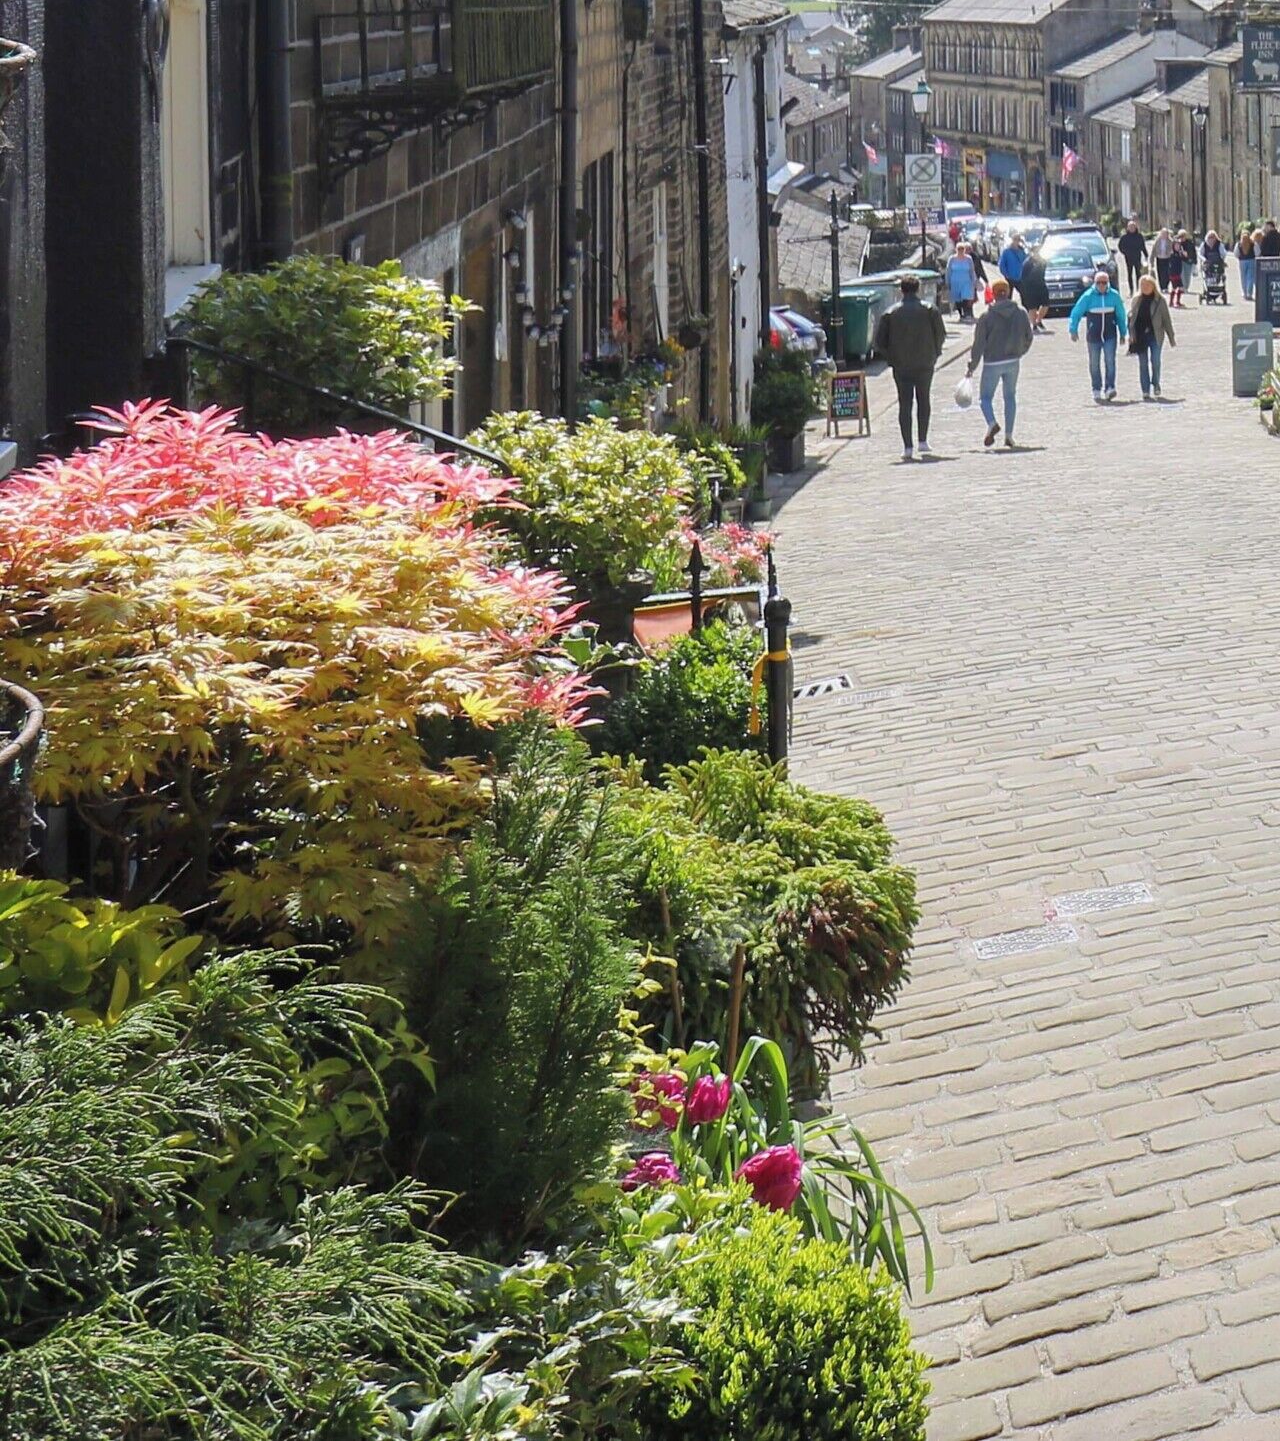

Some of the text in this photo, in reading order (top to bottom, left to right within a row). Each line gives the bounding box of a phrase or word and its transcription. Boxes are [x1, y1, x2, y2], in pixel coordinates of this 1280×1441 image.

[1258, 31, 1274, 40] THE
[1251, 41, 1280, 50] FLEECE
[1258, 50, 1274, 58] INN
[1236, 338, 1267, 360] 71
